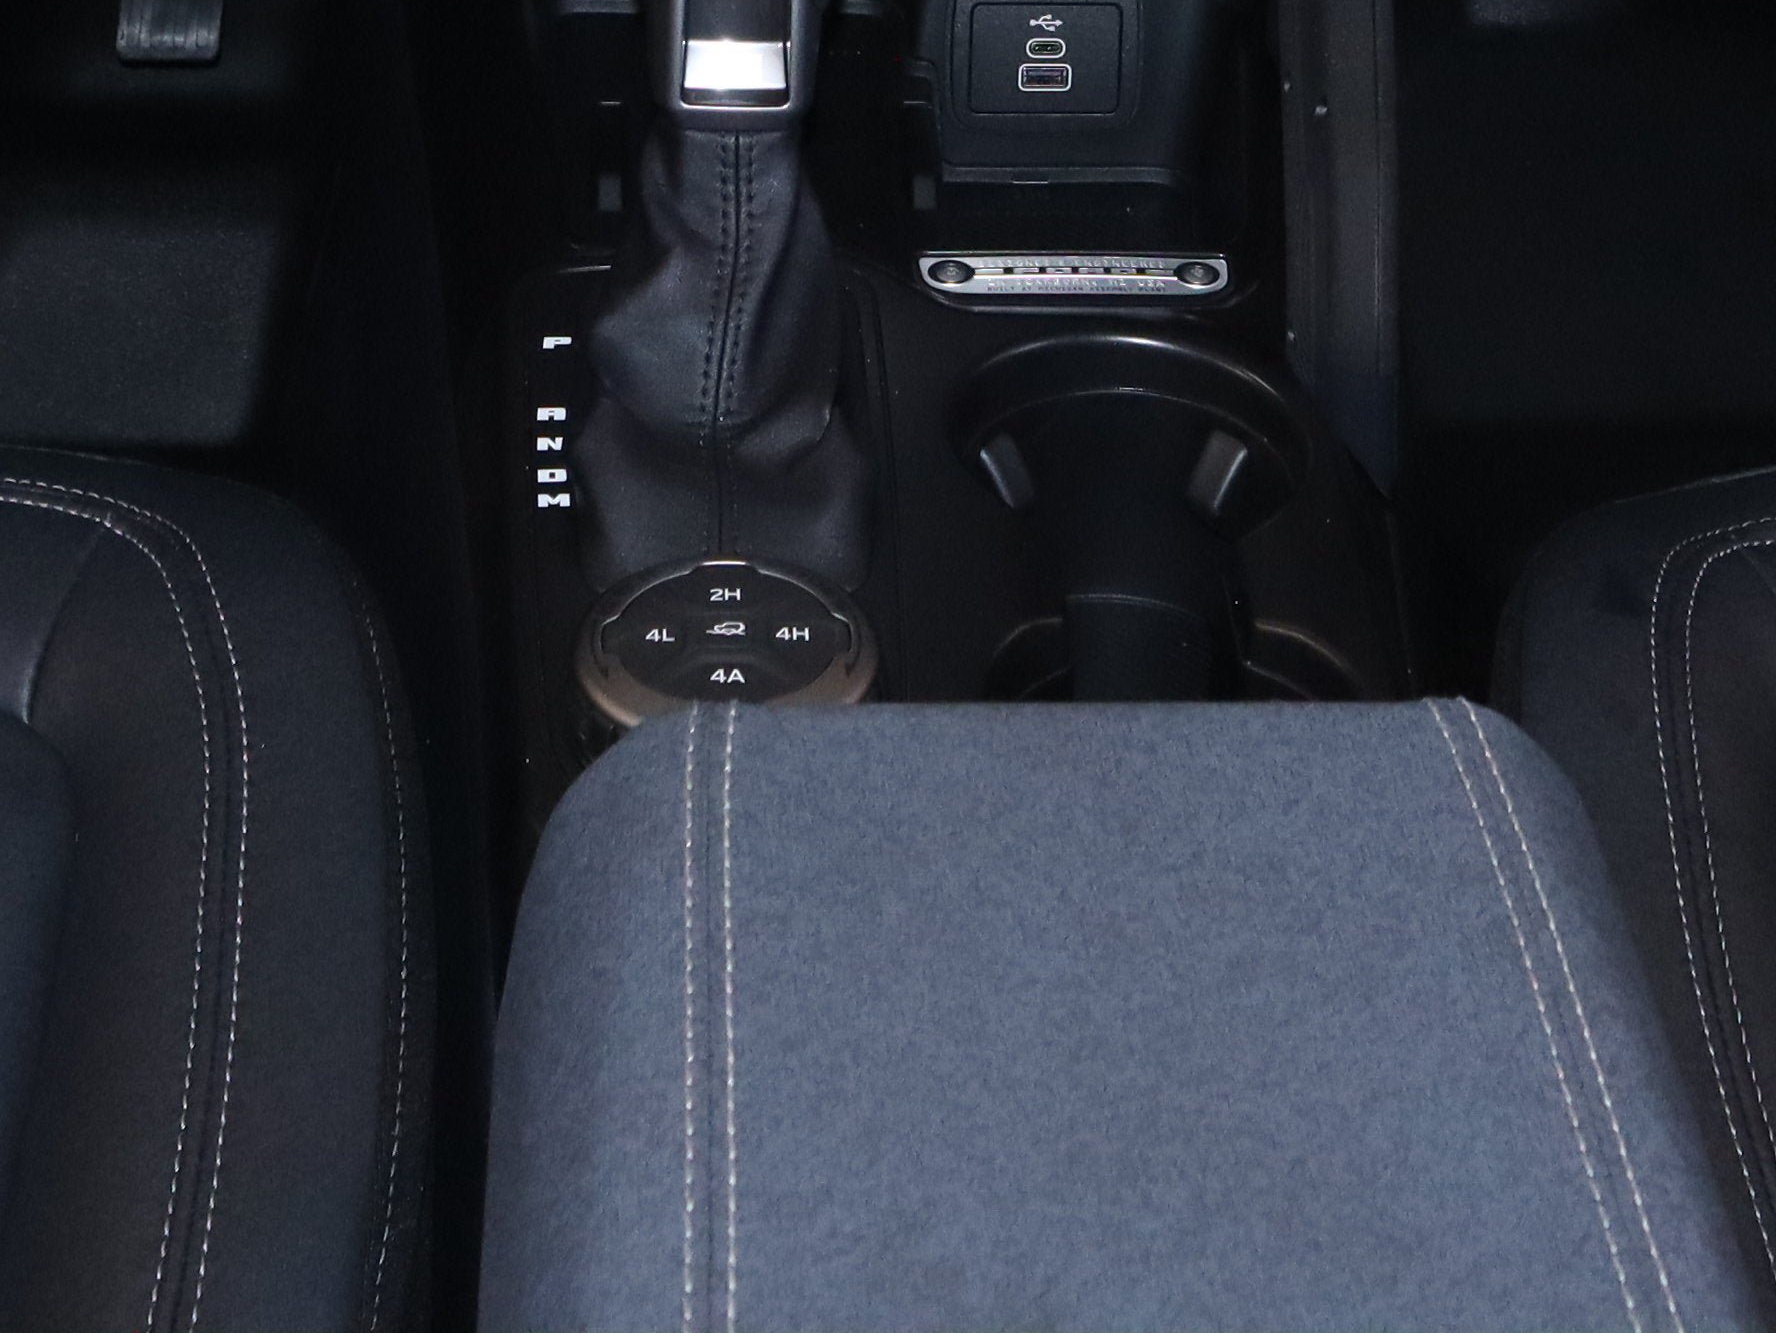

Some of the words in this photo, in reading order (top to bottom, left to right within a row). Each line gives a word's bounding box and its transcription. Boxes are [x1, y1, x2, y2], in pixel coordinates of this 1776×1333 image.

[542, 336, 572, 349] P
[537, 407, 566, 421] R
[537, 437, 563, 451] N
[537, 469, 567, 483] D
[537, 494, 571, 507] M
[709, 588, 741, 601] 2H
[645, 629, 675, 642] 4L
[775, 627, 810, 642] 4H
[710, 669, 745, 683] 4A
